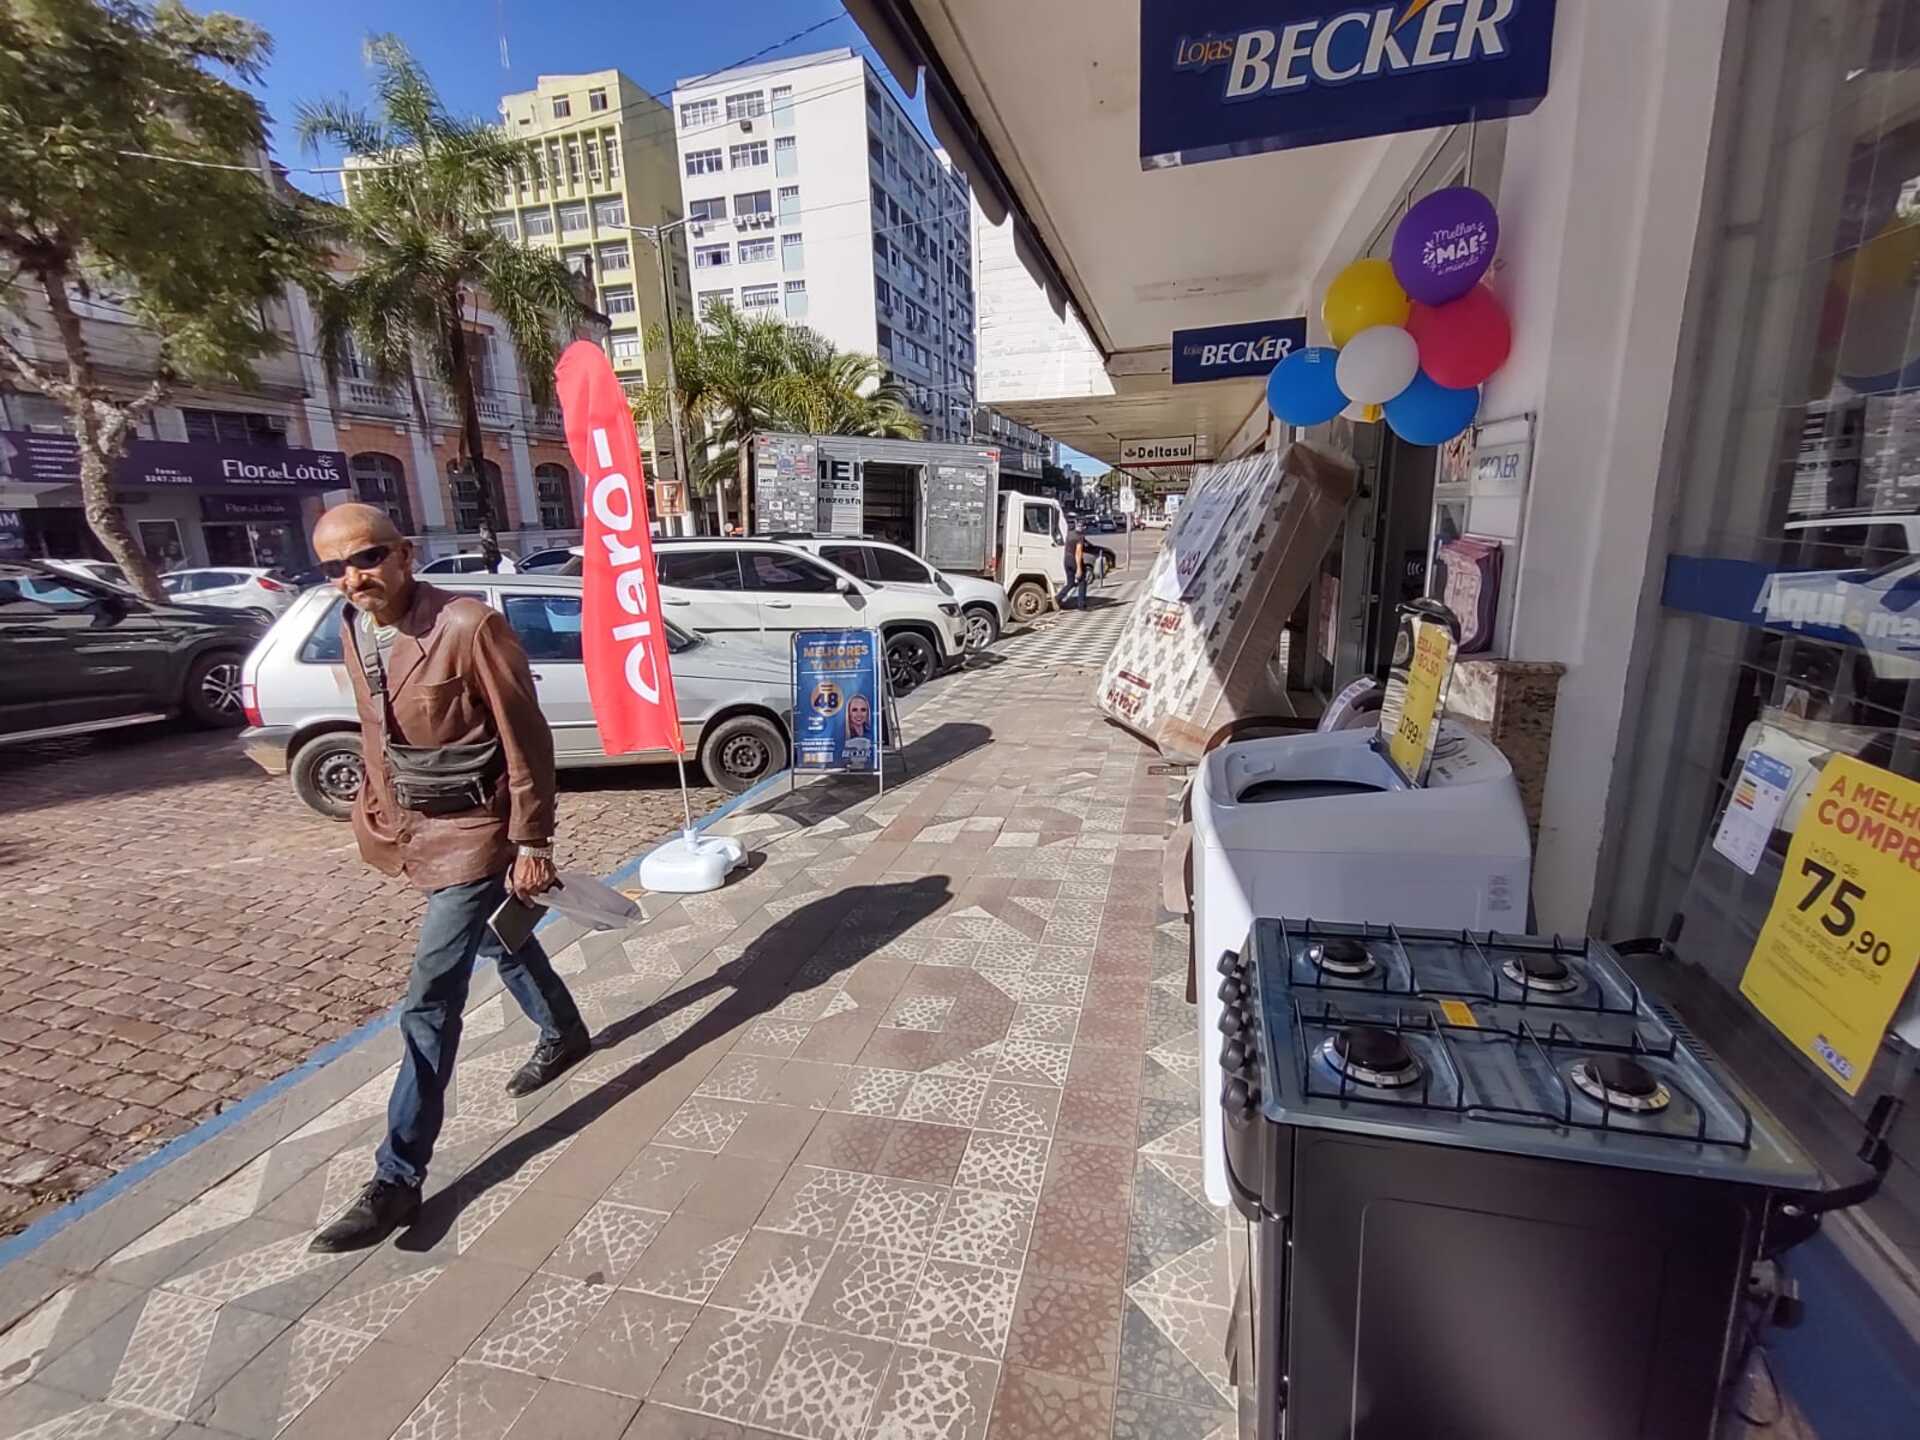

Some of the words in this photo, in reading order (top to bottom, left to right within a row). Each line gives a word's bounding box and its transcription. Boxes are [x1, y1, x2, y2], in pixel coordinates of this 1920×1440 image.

[1177, 32, 1234, 67] Lojas
[1225, 0, 1513, 98] BECKER
[1200, 337, 1292, 367] BECKER
[1137, 443, 1192, 459] Deltasul
[1752, 575, 1848, 629] Aqui
[814, 692, 839, 708] 48
[1829, 775, 1848, 798] A
[1852, 782, 1920, 831] MELH
